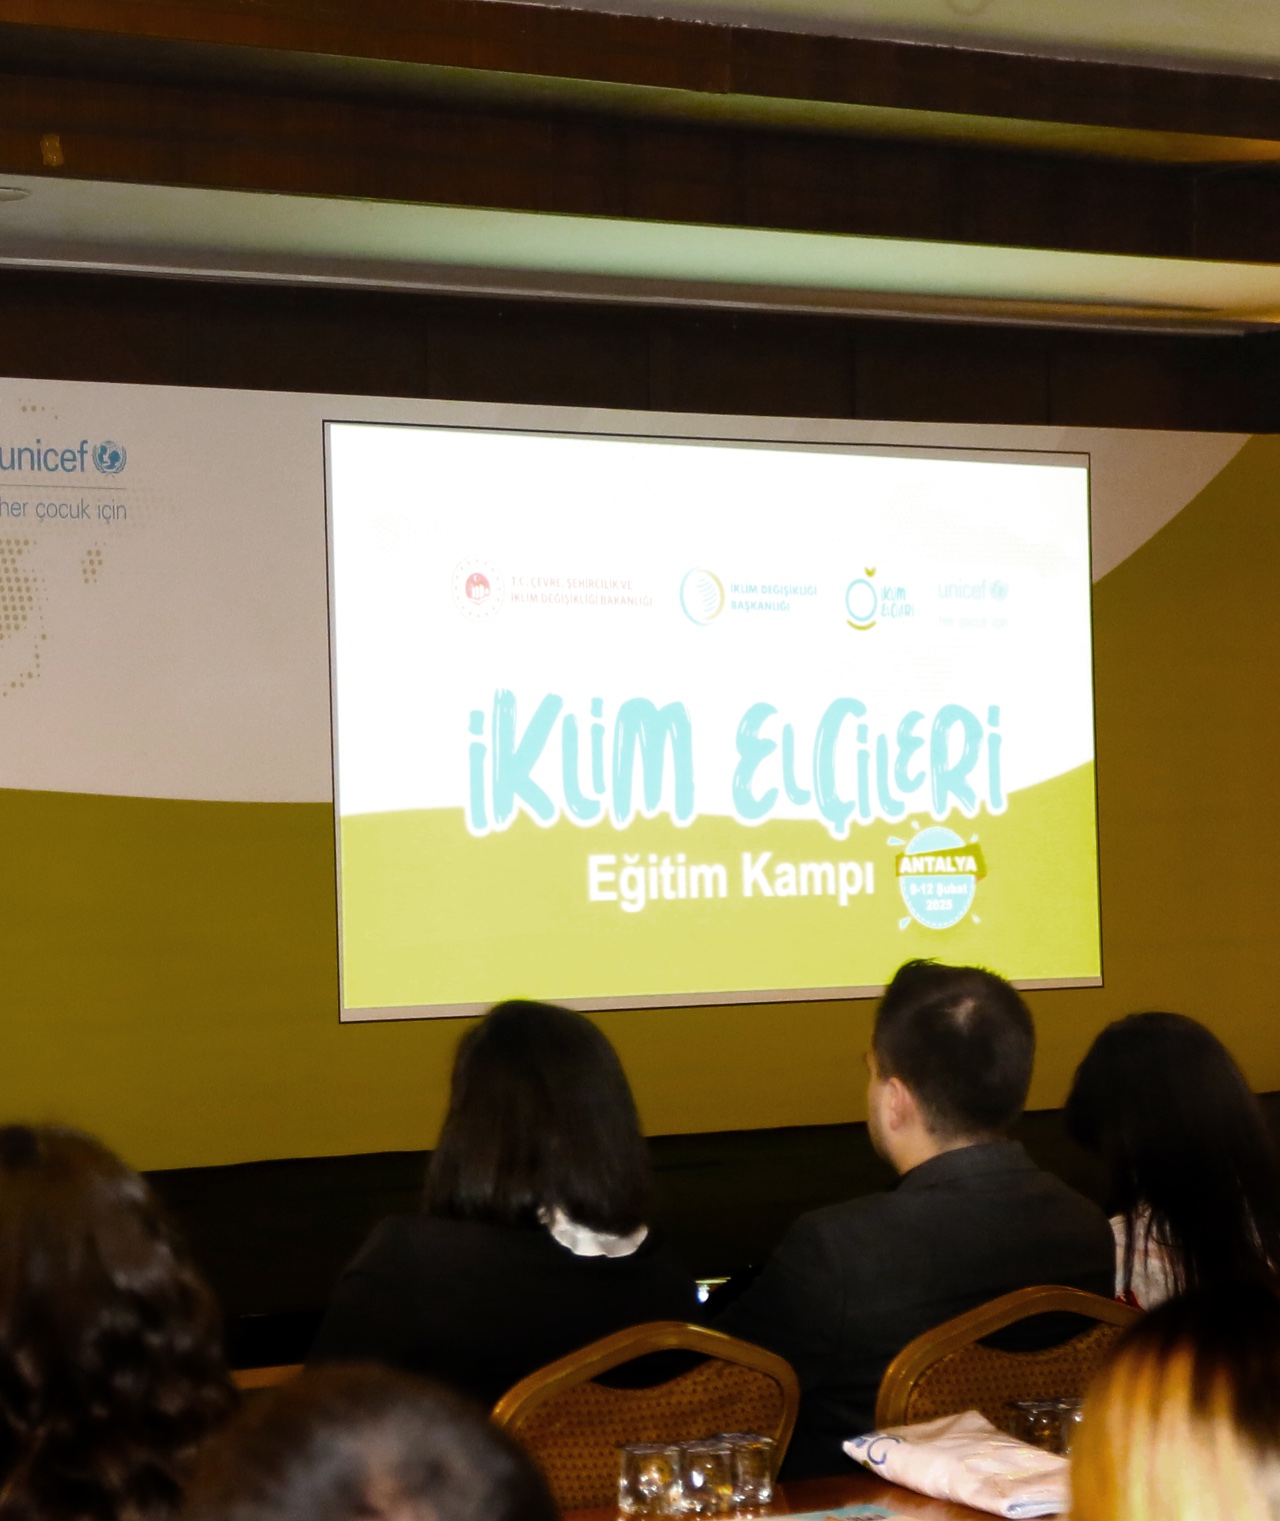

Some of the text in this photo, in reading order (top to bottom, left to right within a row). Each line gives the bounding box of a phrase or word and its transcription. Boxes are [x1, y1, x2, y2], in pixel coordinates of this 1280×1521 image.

[36, 497, 91, 523] çocuk
[97, 499, 127, 525] için
[620, 579, 632, 590] VE
[468, 687, 1003, 834] İKLİM ELÇİLERİ
[899, 855, 978, 873] ANTALYA
[587, 851, 874, 913] Eğitim Kampı
[936, 882, 968, 898] Şubat
[926, 898, 953, 911] 2025
